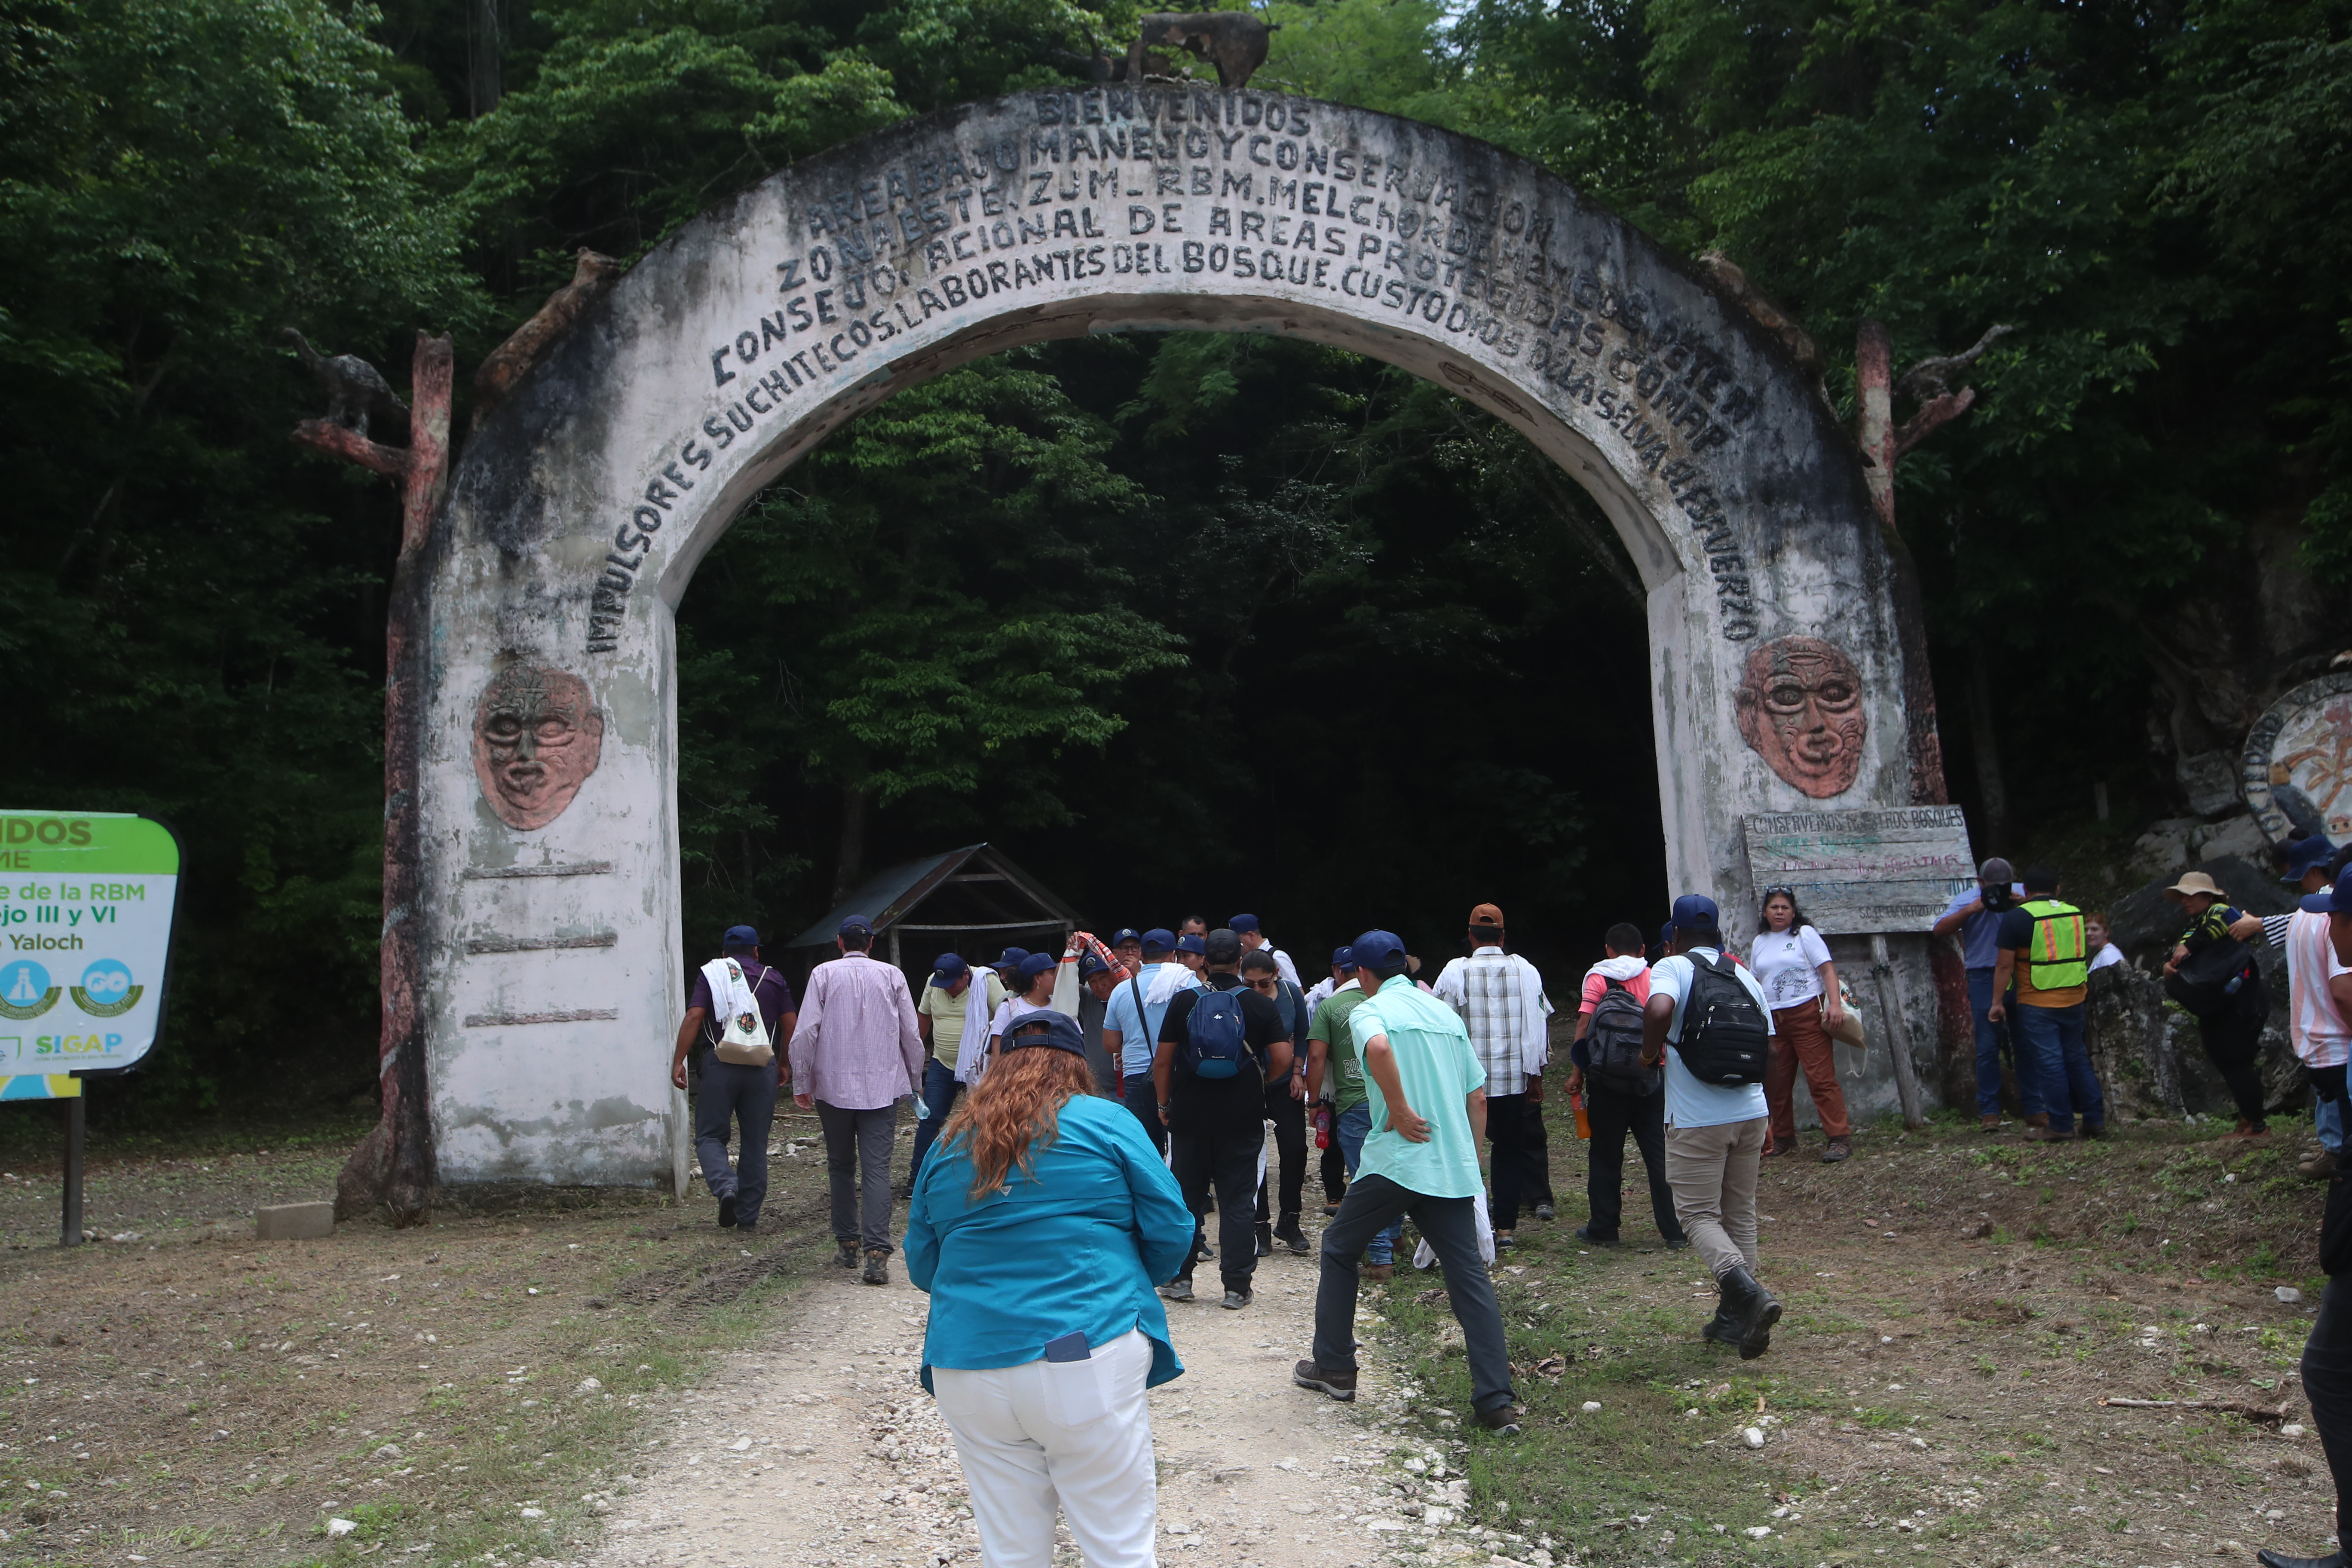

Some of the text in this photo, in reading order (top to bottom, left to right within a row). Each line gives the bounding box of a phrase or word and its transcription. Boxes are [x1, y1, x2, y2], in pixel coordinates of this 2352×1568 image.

[1035, 89, 1311, 136] BIENVENIDOS
[1029, 126, 1208, 165] MANEJO
[1249, 135, 1554, 248] CONSERVACION
[1129, 202, 1182, 235] DE
[1209, 206, 1346, 256] AREAS
[1358, 232, 1605, 356] PROTEGIDAS
[1609, 347, 1728, 452] CONAP
[1651, 320, 1757, 423] PETEN
[587, 439, 712, 652] IMPULSORES
[896, 243, 1106, 328] LABORANTES
[1113, 242, 1170, 274] DEL
[1342, 264, 1525, 356] CUSTODIOS
[1753, 813, 1842, 834] CONSERVEMOS
[1911, 807, 1963, 828] BOSQUES
[20, 882, 51, 900] de
[61, 882, 81, 900] la
[91, 884, 145, 900] RBM
[0, 904, 115, 926] jo III y VI
[9, 934, 83, 950] Yaloch
[37, 1034, 122, 1054] SIGAP
